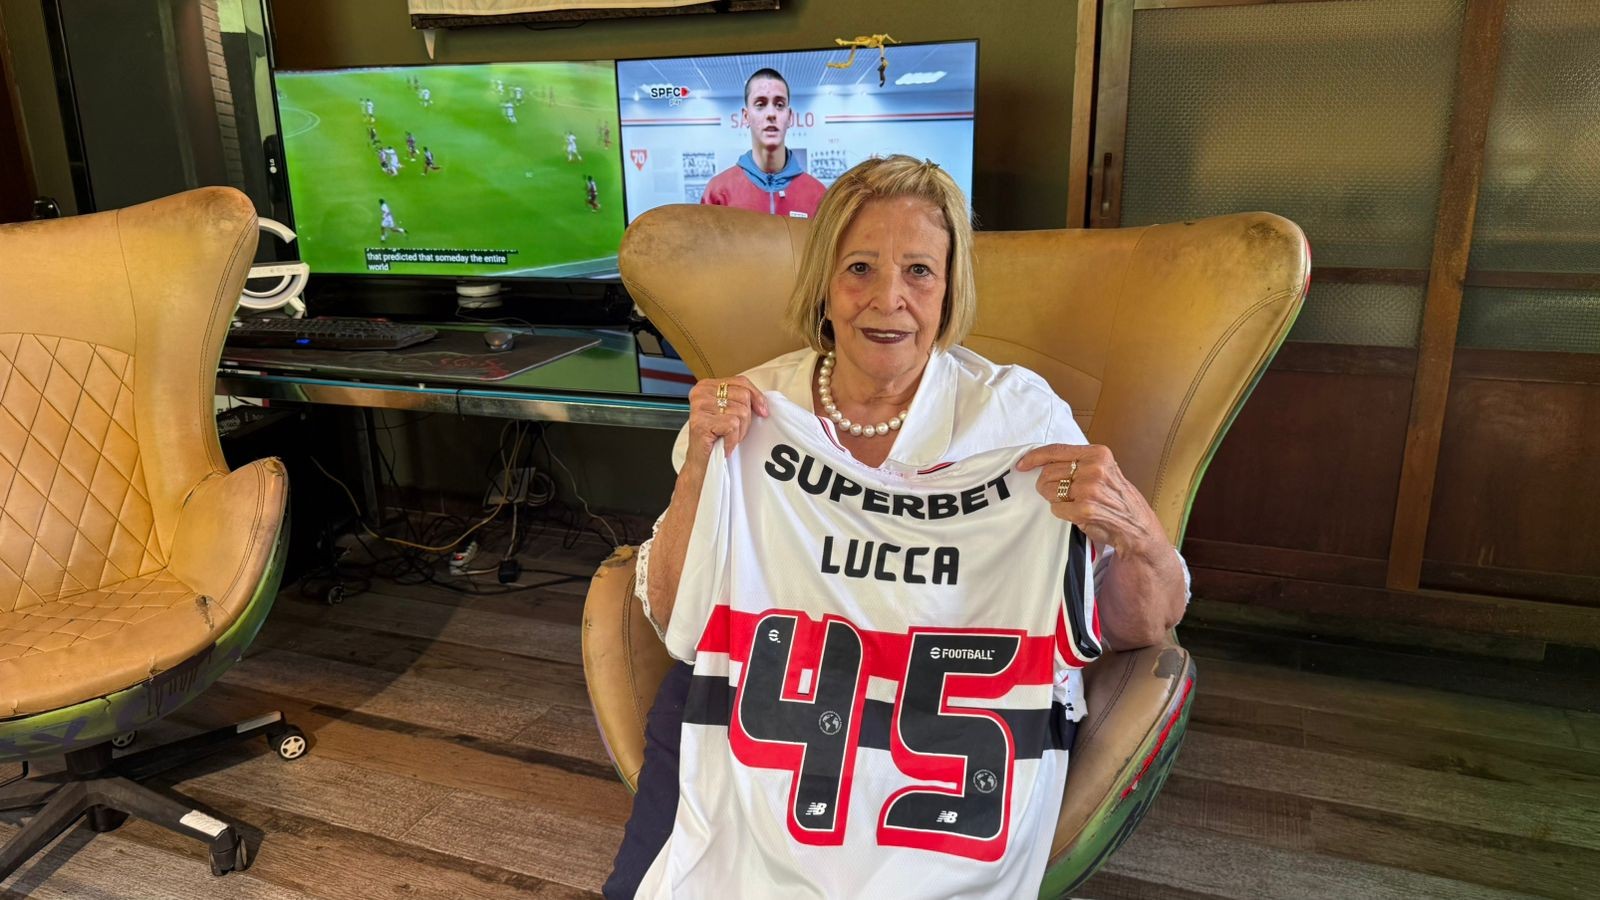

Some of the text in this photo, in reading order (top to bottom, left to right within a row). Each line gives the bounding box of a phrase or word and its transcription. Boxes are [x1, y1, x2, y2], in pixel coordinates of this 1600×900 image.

[650, 87, 681, 98] SPFC
[367, 252, 506, 264] that predicted that someday the entire
[368, 263, 389, 271] world
[764, 443, 1011, 520] SUPERBET
[821, 536, 960, 585] LUCCA
[736, 613, 1022, 845] 45
